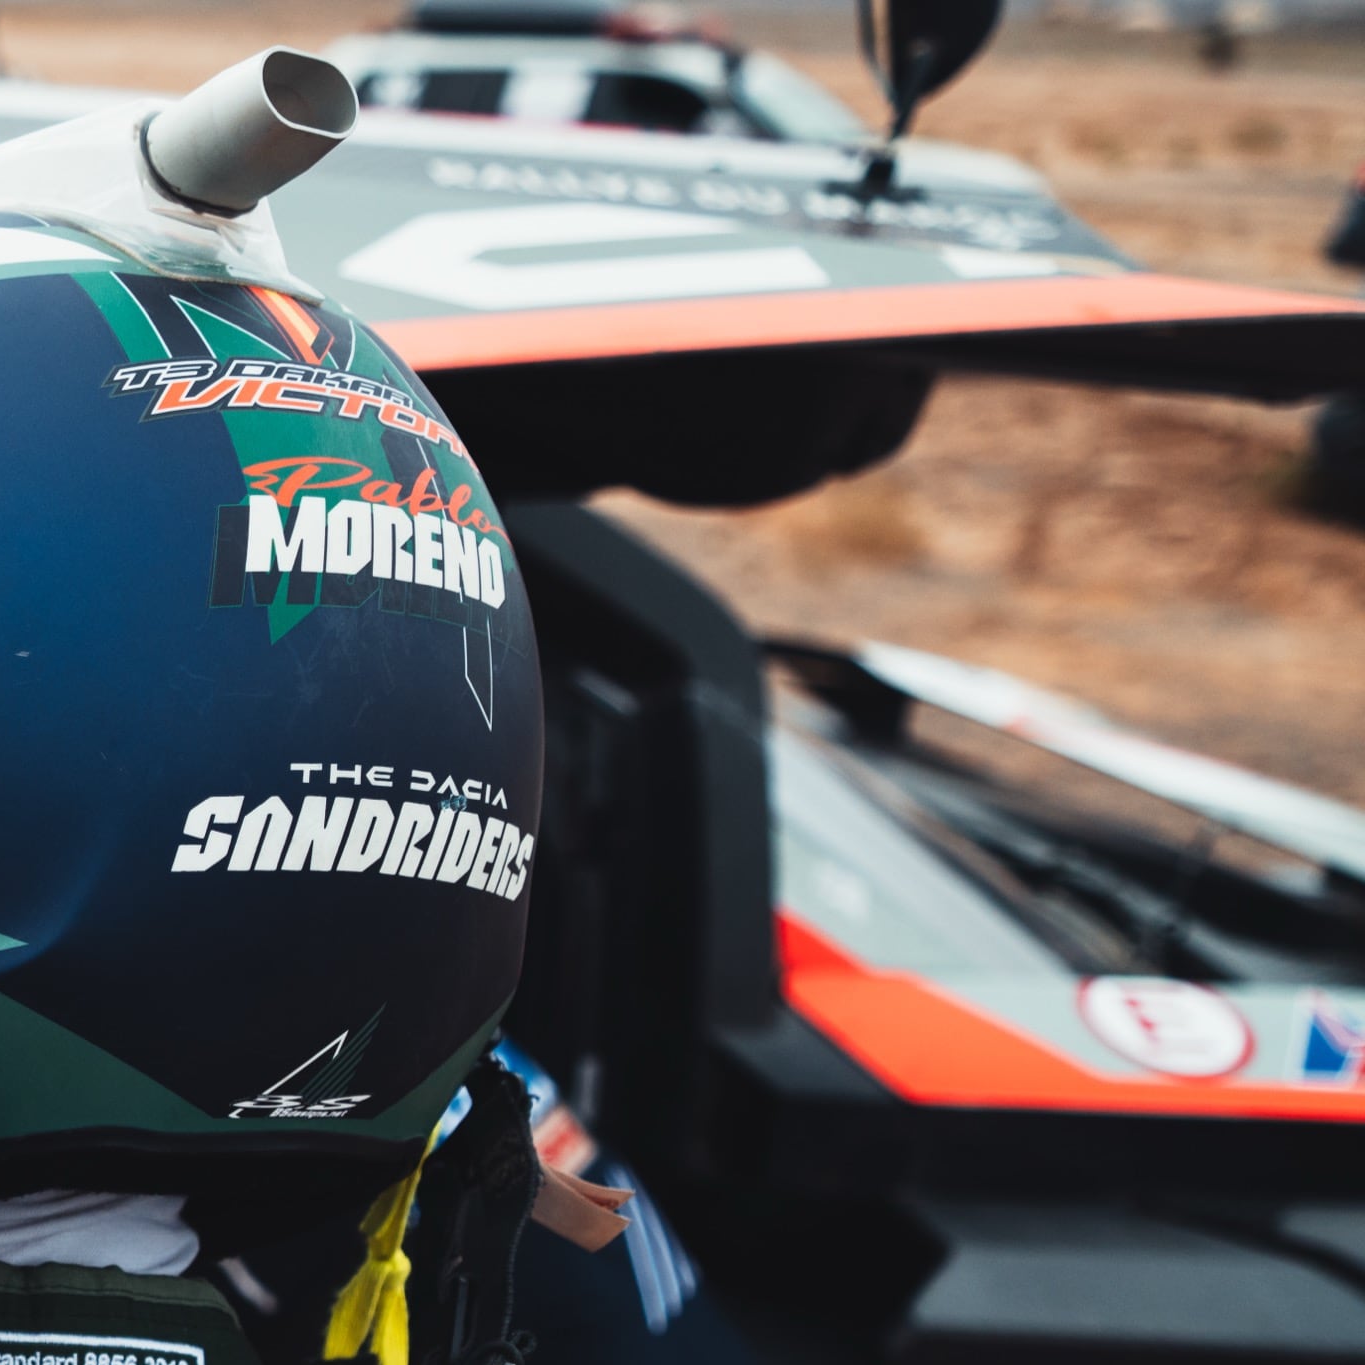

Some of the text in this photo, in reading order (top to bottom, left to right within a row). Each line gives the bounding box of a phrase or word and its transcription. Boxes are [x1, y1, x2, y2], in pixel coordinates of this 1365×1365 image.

[113, 358, 414, 408] T3 DAKAR
[150, 376, 482, 474] VICTOR
[242, 456, 513, 550] Pablo
[245, 495, 506, 610] MORENO
[289, 762, 509, 810] THE DACIA
[170, 795, 535, 902] SANDRIDERS
